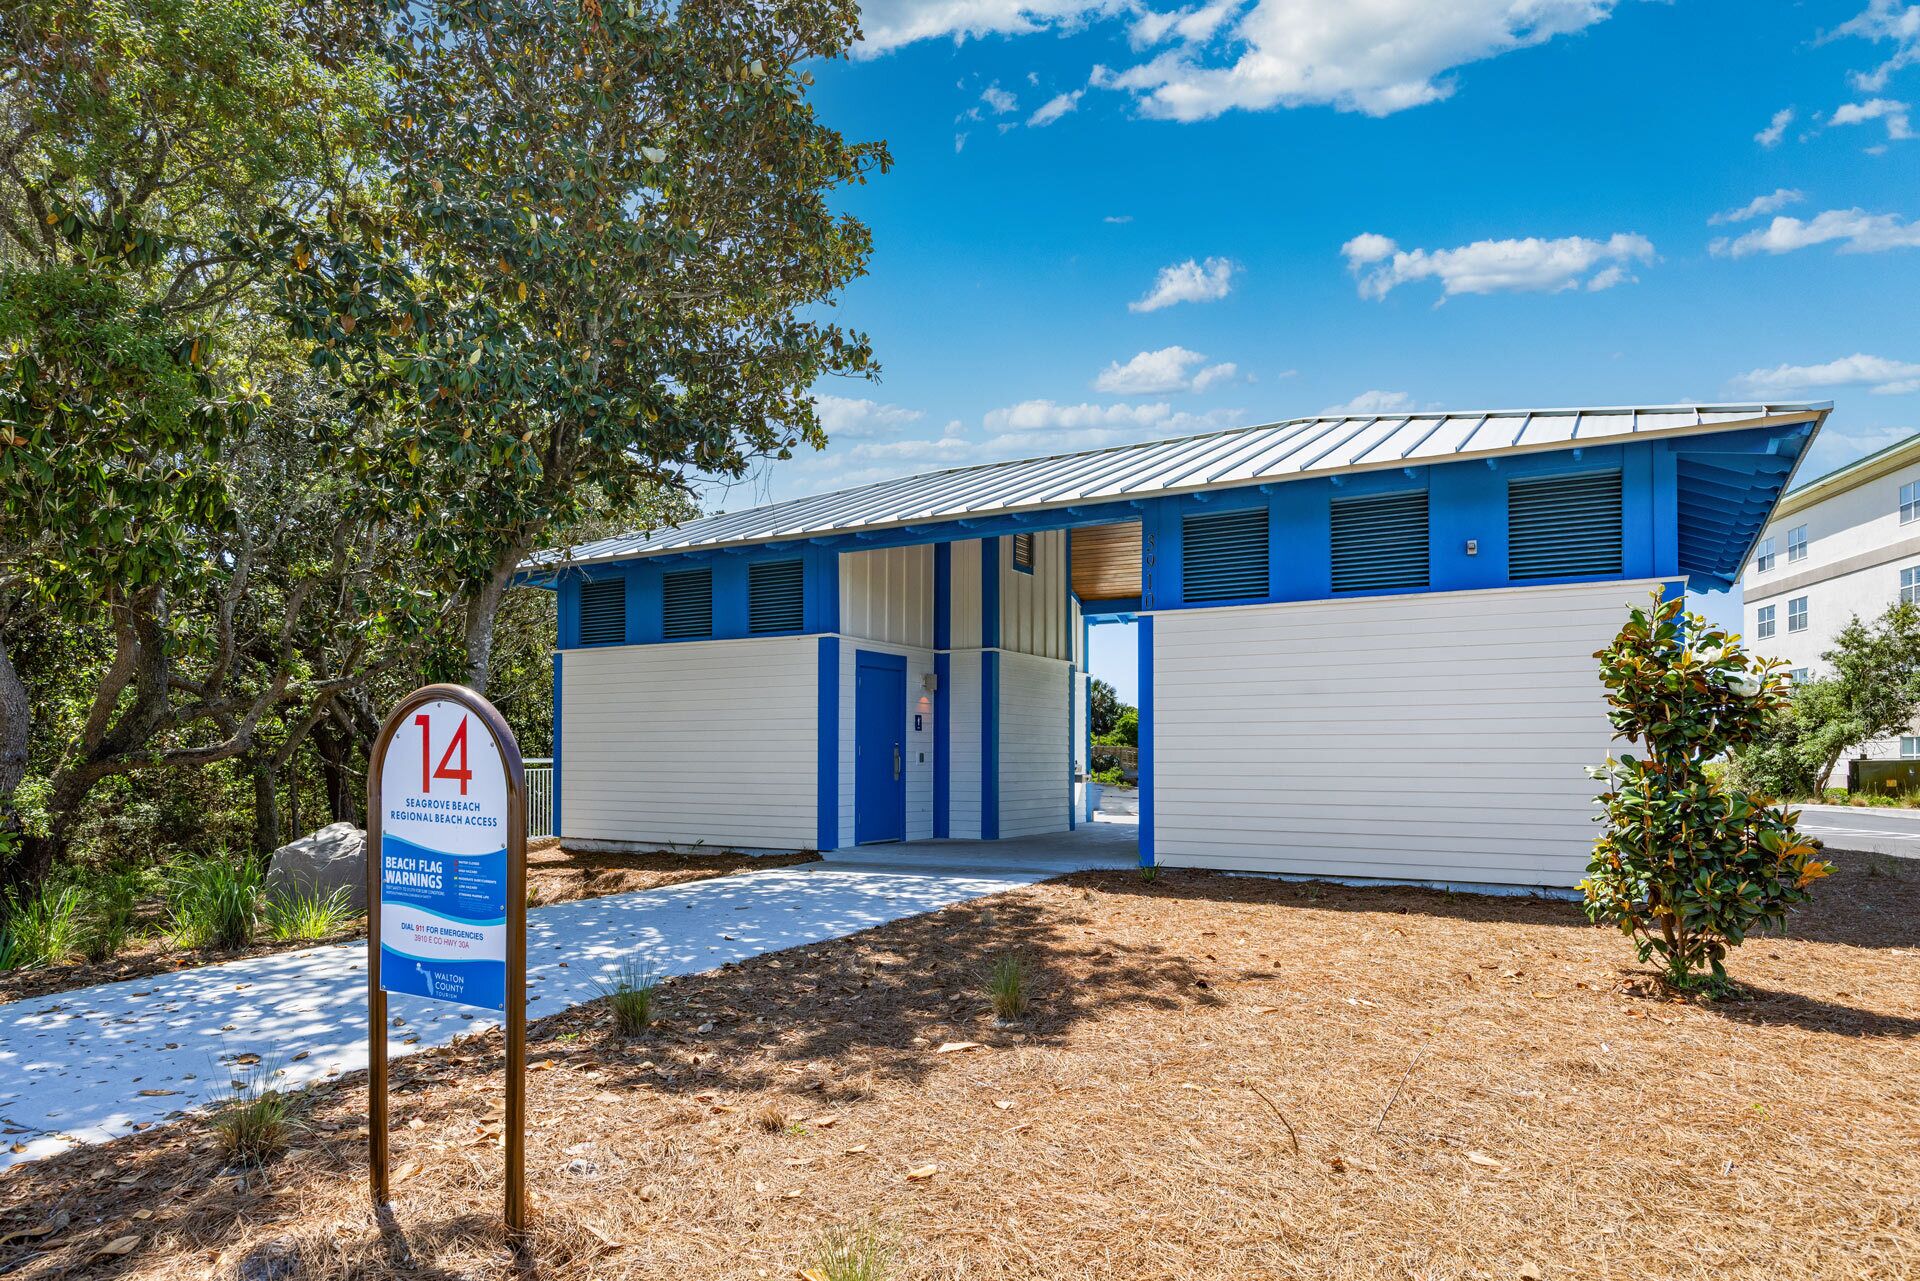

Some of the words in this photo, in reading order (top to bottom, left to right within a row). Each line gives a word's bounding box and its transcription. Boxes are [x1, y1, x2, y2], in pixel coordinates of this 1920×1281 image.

[415, 713, 472, 795] 14
[405, 798, 450, 810] SEAGROVE
[452, 801, 480, 812] BEACH
[390, 810, 433, 823] REGIONAL
[434, 813, 463, 824] BEACH
[464, 816, 498, 827] ACCESS
[385, 856, 416, 871] BEACH
[419, 860, 443, 874] FLAG
[385, 869, 443, 890] WARNINGS
[401, 922, 414, 931] DIAL
[426, 926, 439, 935] FOR
[440, 927, 484, 941] EMERGENCIES
[414, 934, 427, 943] 3910
[433, 937, 443, 945] CO
[443, 938, 458, 947] HWY
[458, 940, 470, 949] 30A
[434, 971, 464, 984] WALTON
[434, 981, 464, 994] COUNTY
[435, 991, 458, 999] TOURISM
